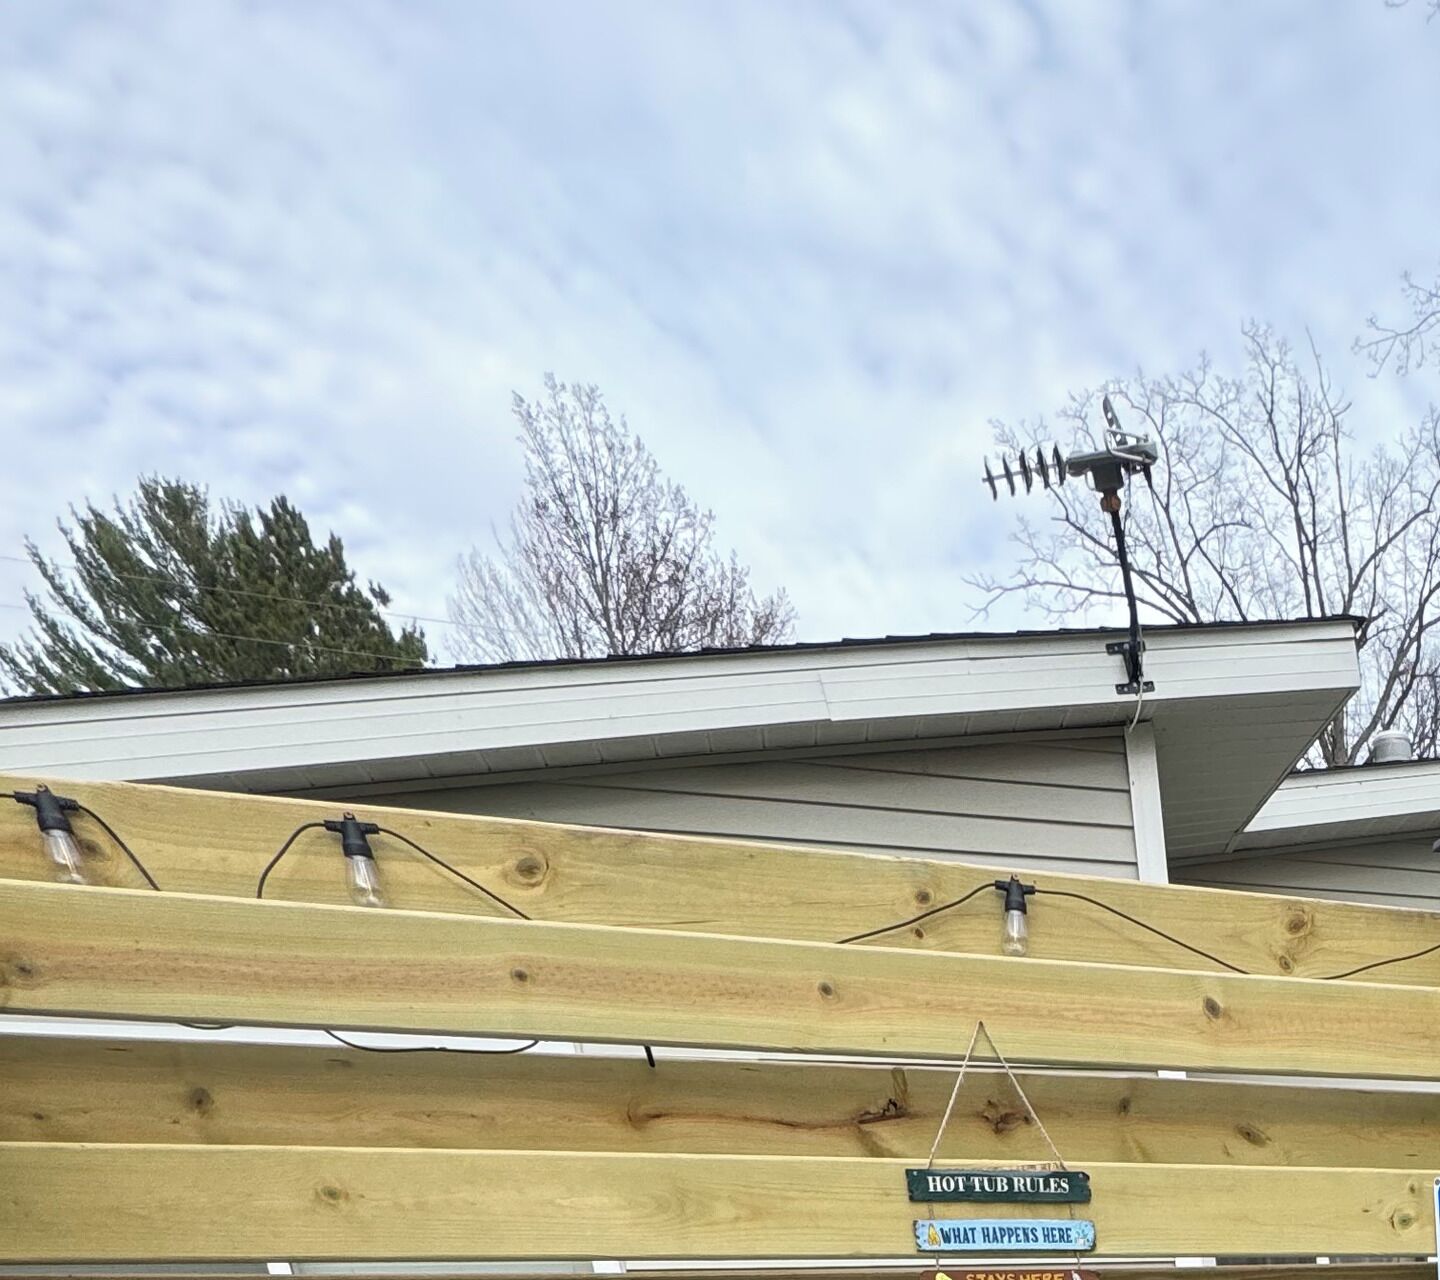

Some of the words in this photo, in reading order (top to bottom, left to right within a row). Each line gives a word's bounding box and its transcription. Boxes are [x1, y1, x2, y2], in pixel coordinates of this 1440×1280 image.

[927, 1175, 967, 1193] HOT
[970, 1176, 1009, 1193] TUB
[1013, 1177, 1070, 1194] RULES
[940, 1227, 977, 1245] WHAT
[983, 1227, 1039, 1245] HAPPENS
[1043, 1226, 1073, 1244] HERE
